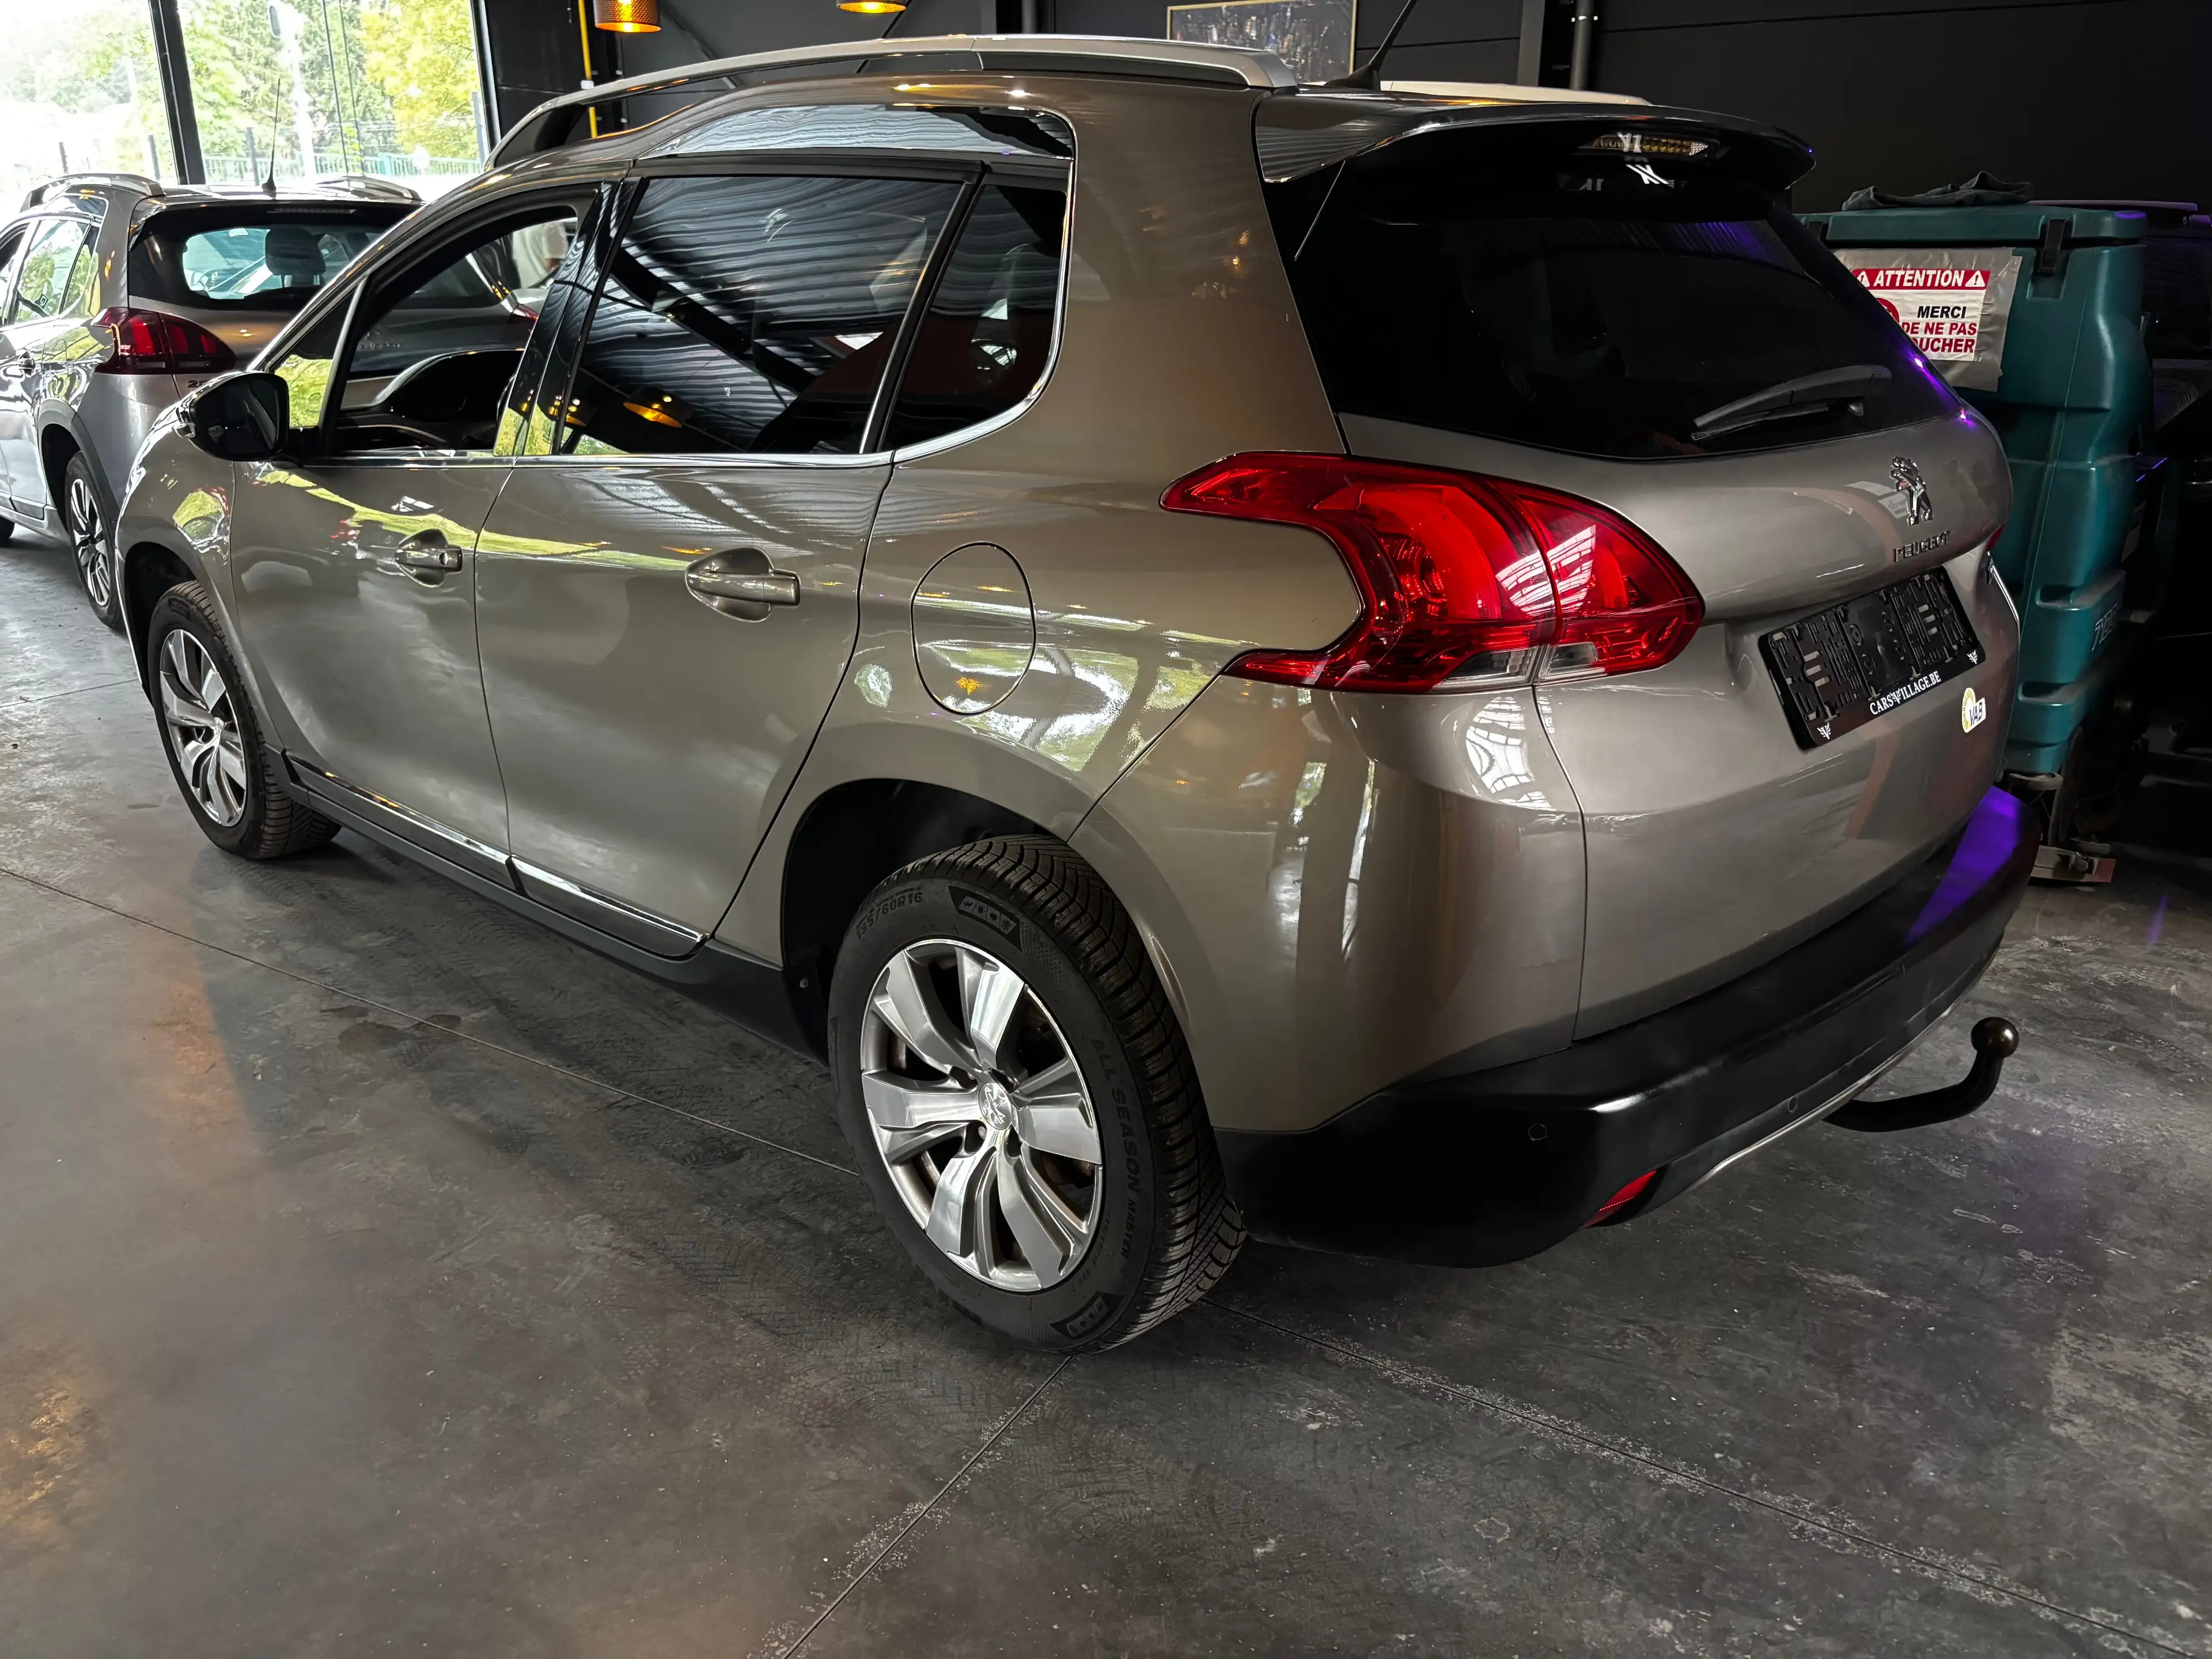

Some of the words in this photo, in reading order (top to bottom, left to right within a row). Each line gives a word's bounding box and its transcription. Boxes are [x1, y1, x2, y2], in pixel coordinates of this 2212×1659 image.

[1873, 270, 1965, 287] ATTENTION
[1917, 305, 1967, 319] MERCI
[1902, 322, 1919, 335] DE
[1924, 322, 1944, 335] NE
[1948, 323, 1978, 336] PAS
[1893, 530, 1951, 563] PEUGEOT
[1869, 671, 1942, 715] CARSVILLAGE.BE
[1969, 701, 1983, 727] VAB
[1091, 1039, 1118, 1081] ALL
[1111, 1088, 1141, 1194] SEASON
[1120, 1199, 1137, 1259] MASTER
